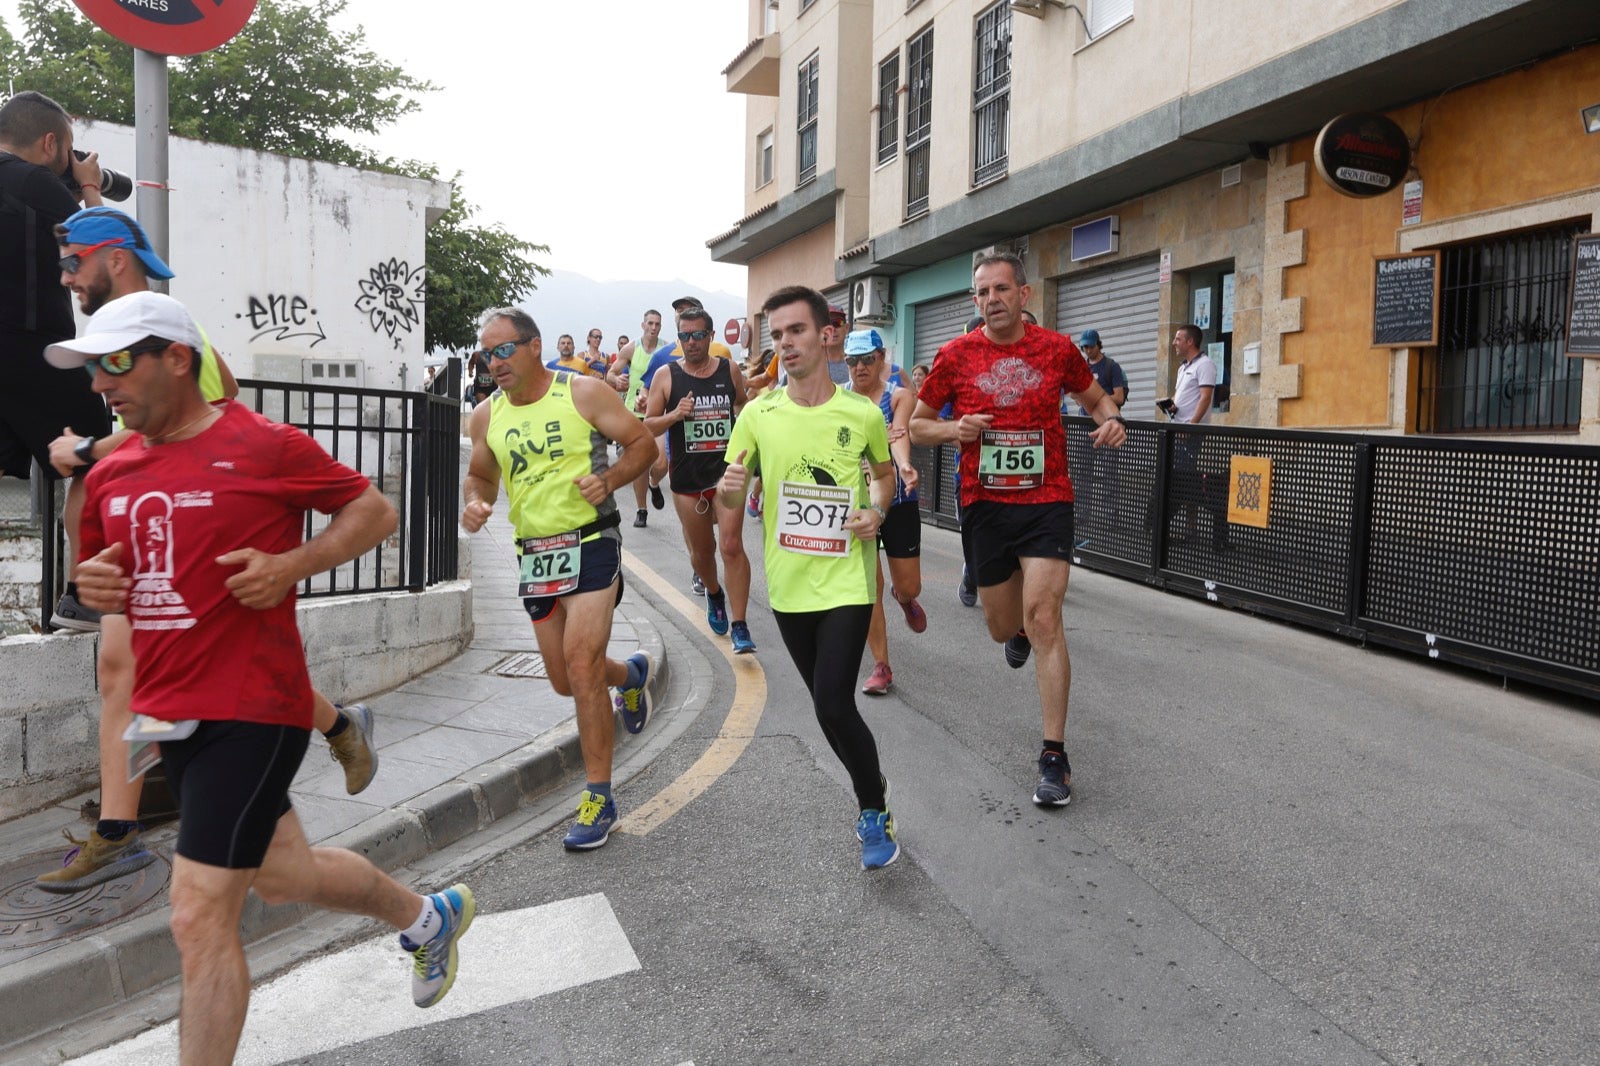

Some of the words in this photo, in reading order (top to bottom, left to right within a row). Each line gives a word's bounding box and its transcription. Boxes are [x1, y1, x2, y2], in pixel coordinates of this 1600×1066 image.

[119, 0, 168, 11] ARES
[692, 394, 730, 407] ANADA
[693, 421, 726, 439] 506
[992, 449, 1035, 470] 156
[785, 500, 850, 531] 3077
[785, 535, 833, 550] Cruzcampo
[532, 552, 572, 577] 872
